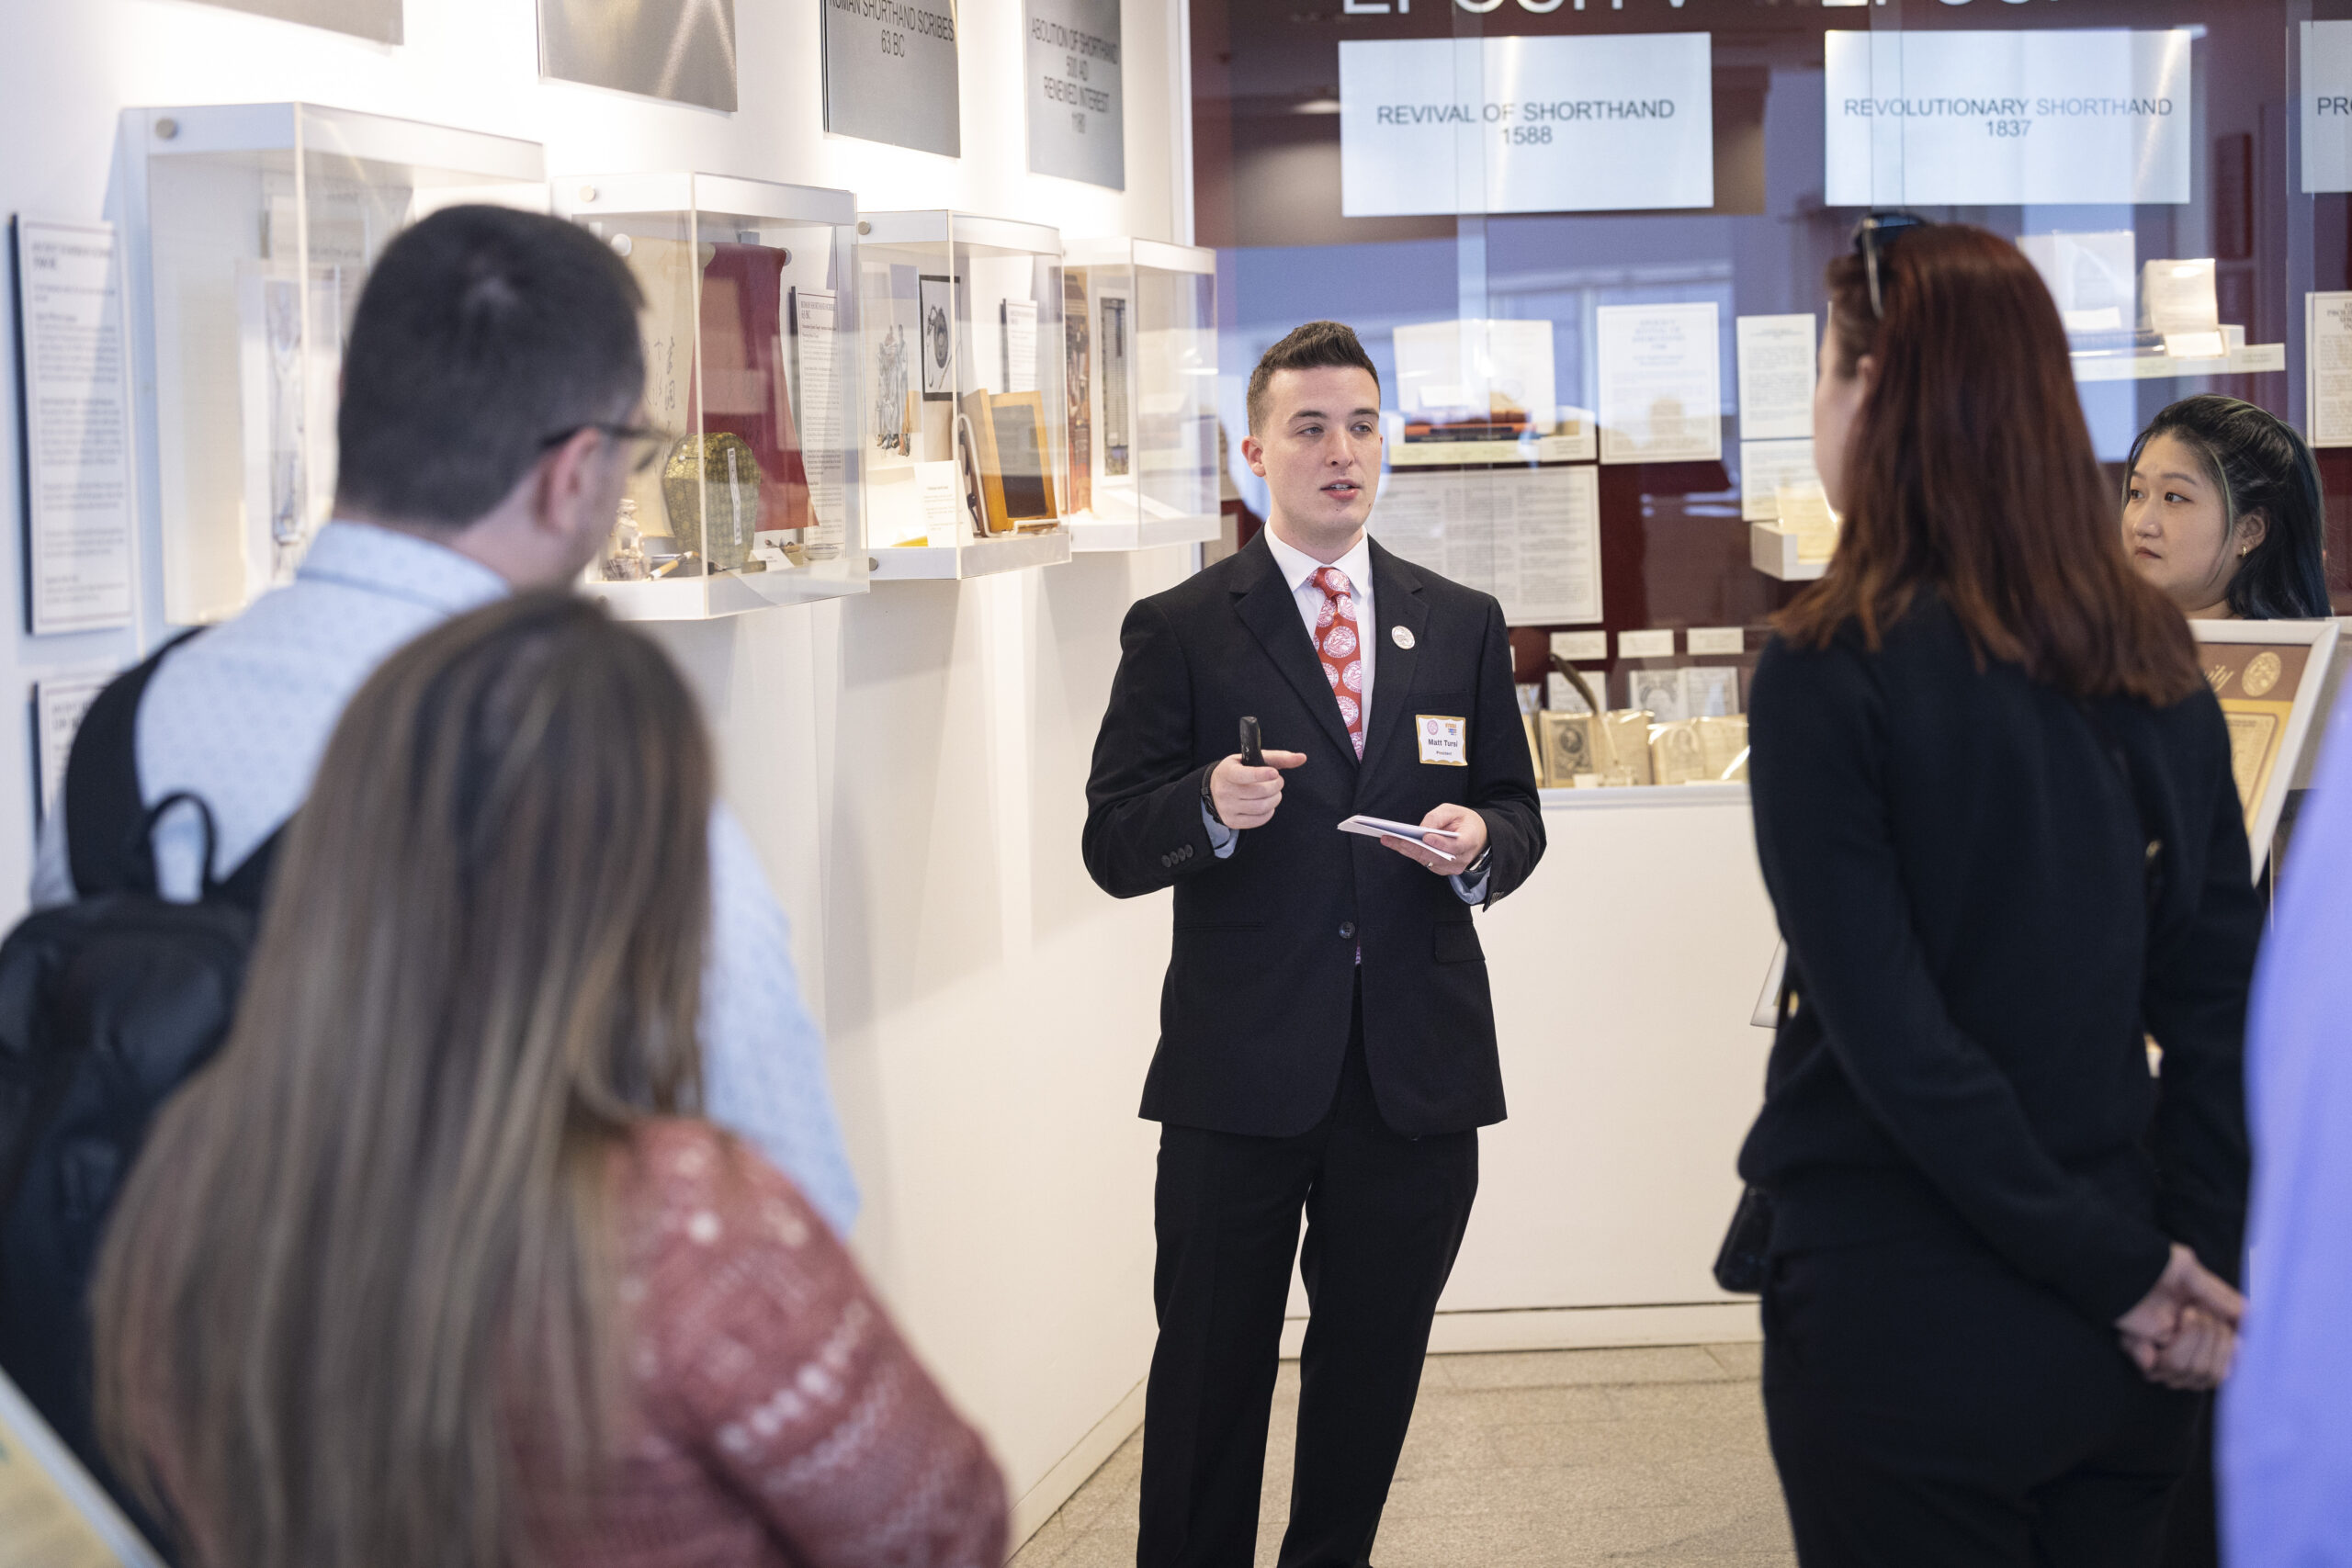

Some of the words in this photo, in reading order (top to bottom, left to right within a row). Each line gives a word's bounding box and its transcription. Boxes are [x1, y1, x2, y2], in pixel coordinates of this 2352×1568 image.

[863, 0, 916, 31] SHORTHAND
[917, 10, 955, 42] SCRIBES
[1031, 18, 1069, 48] ABOLITION
[881, 29, 891, 54] 63
[893, 32, 905, 58] BC
[1377, 105, 1476, 125] REVIVAL
[1482, 103, 1516, 123] OF
[1522, 99, 1675, 121] SHORTHAND
[1844, 98, 2029, 117] REVOLUTIONARY
[2035, 97, 2173, 117] SHORTHAND
[2317, 96, 2352, 116] PR
[1502, 125, 1553, 145] 1588
[1986, 119, 2032, 138] 1837
[1428, 739, 1442, 747] Matt
